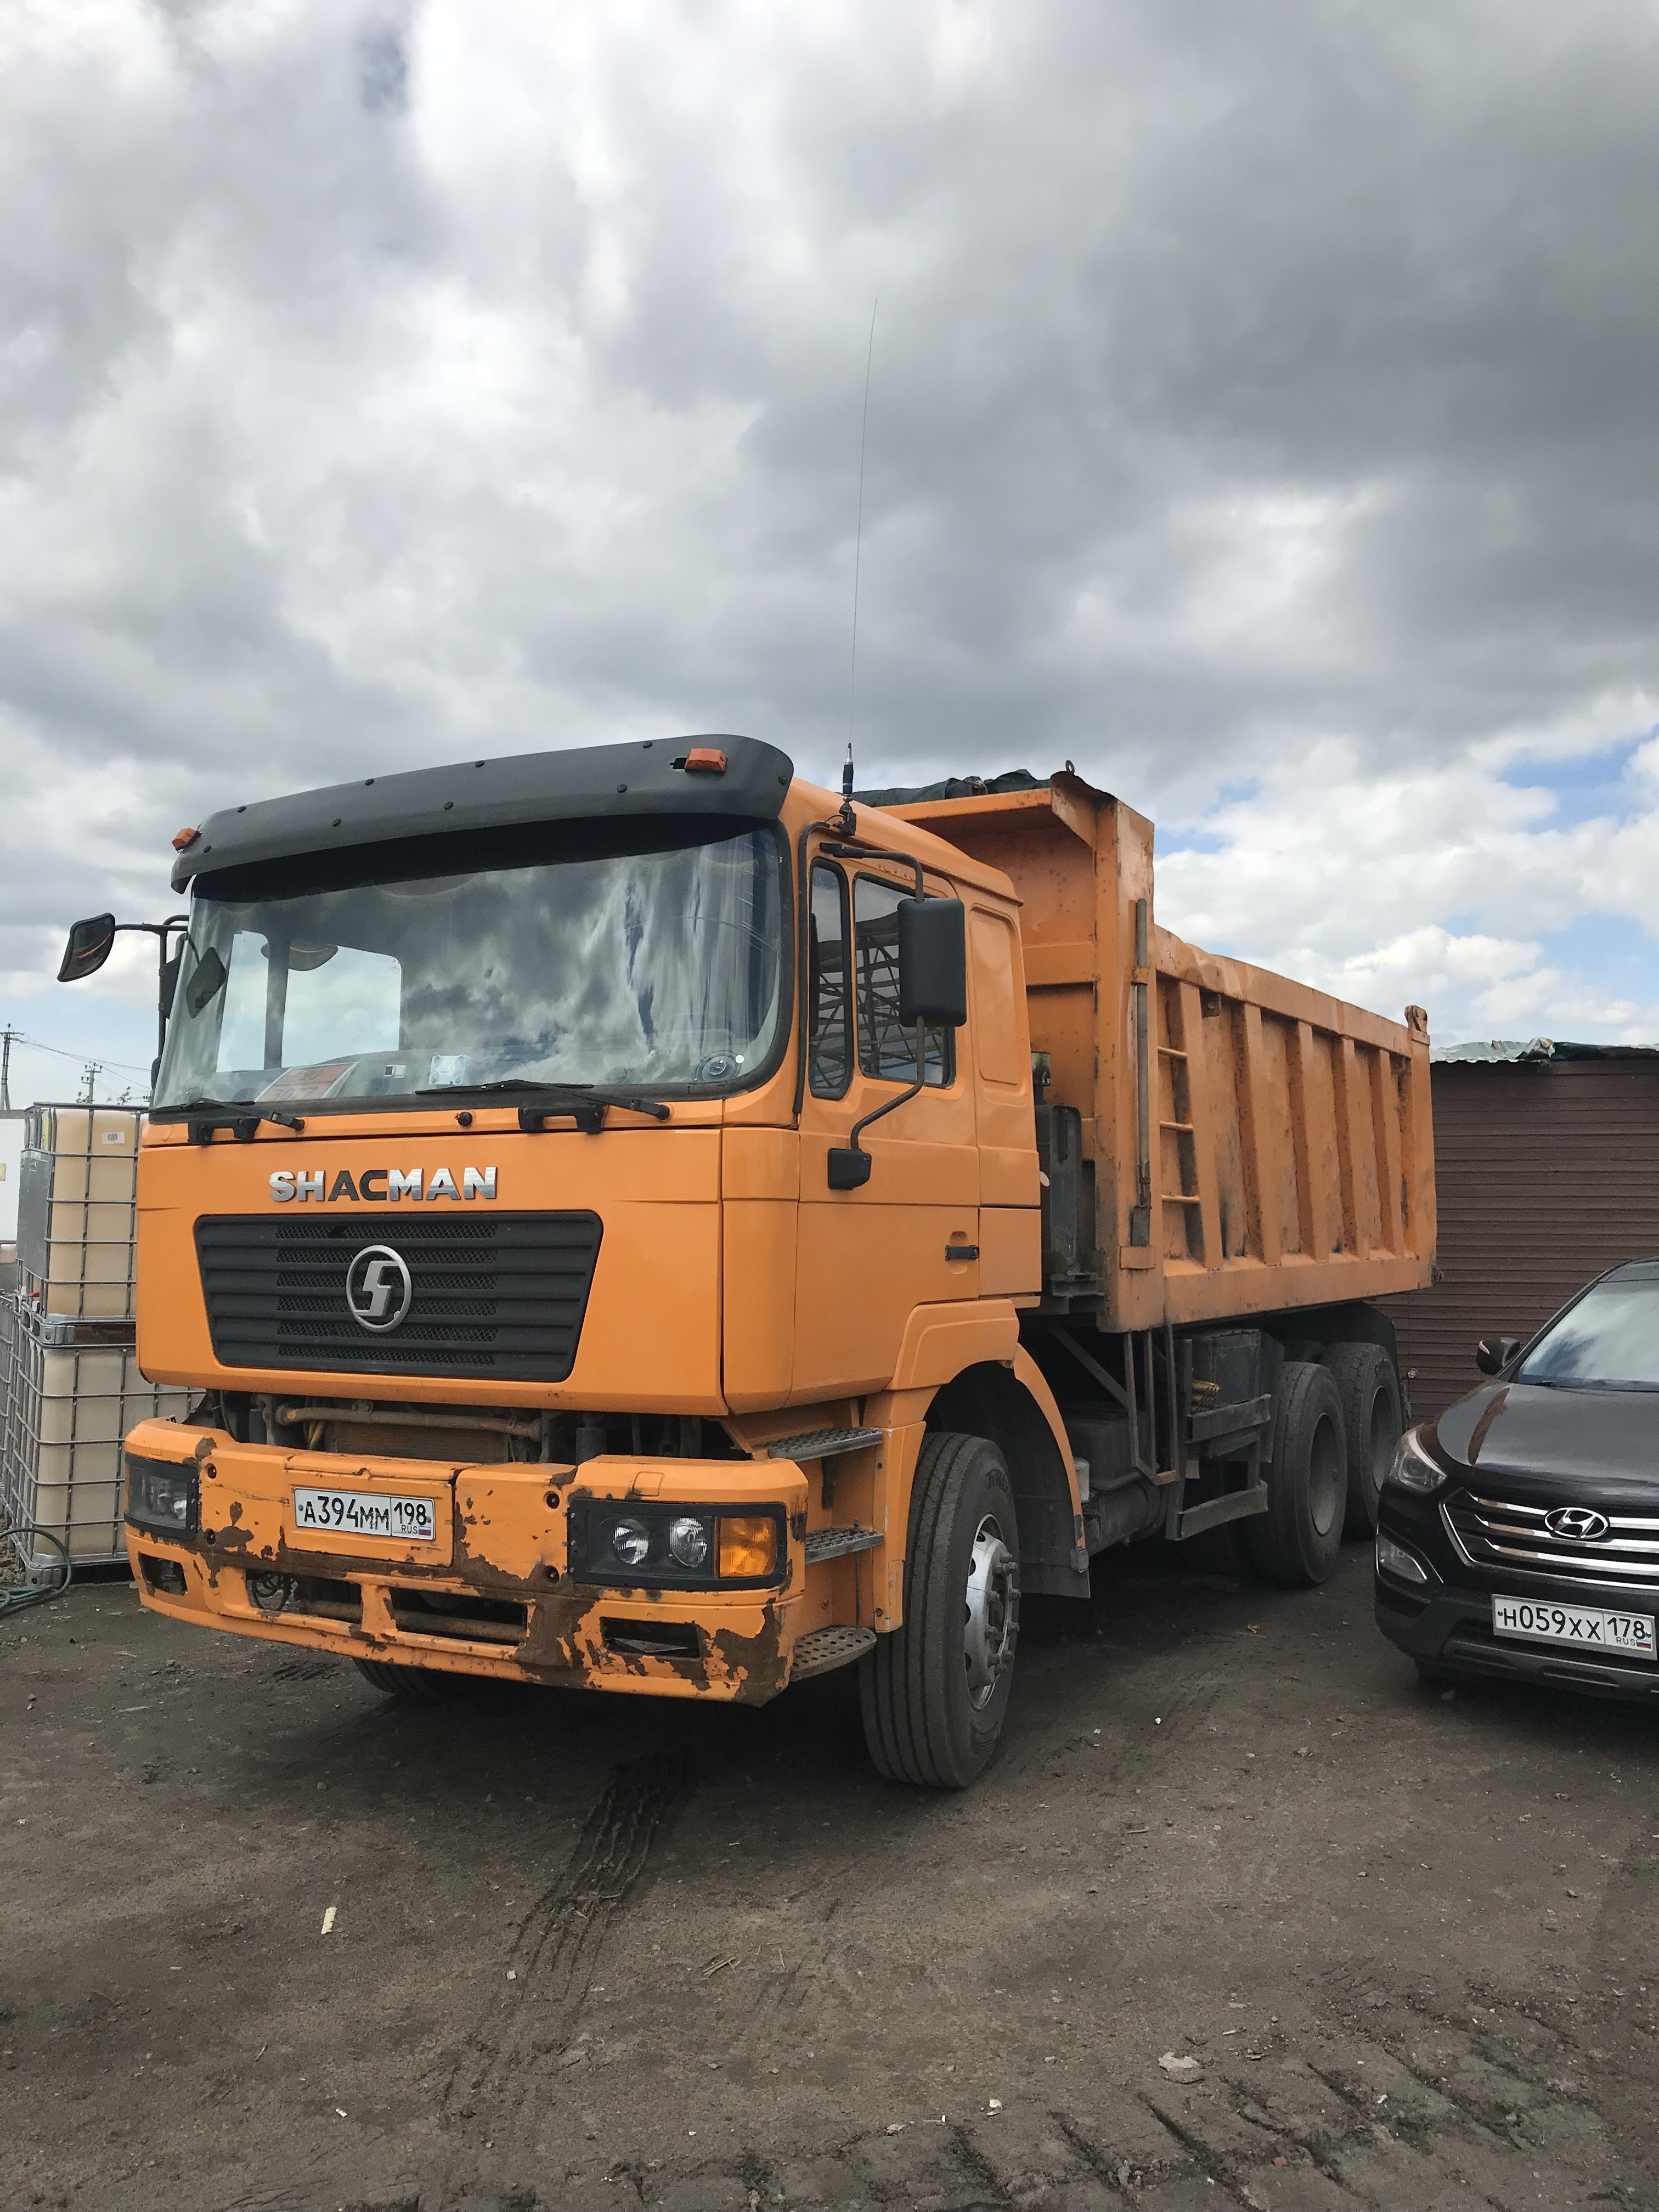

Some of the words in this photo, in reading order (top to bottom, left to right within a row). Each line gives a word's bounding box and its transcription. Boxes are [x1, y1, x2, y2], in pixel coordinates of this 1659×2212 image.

[269, 1167, 498, 1202] SHACMAN
[401, 1525, 418, 1534] RUS
[1616, 1637, 1636, 1646] RUS
